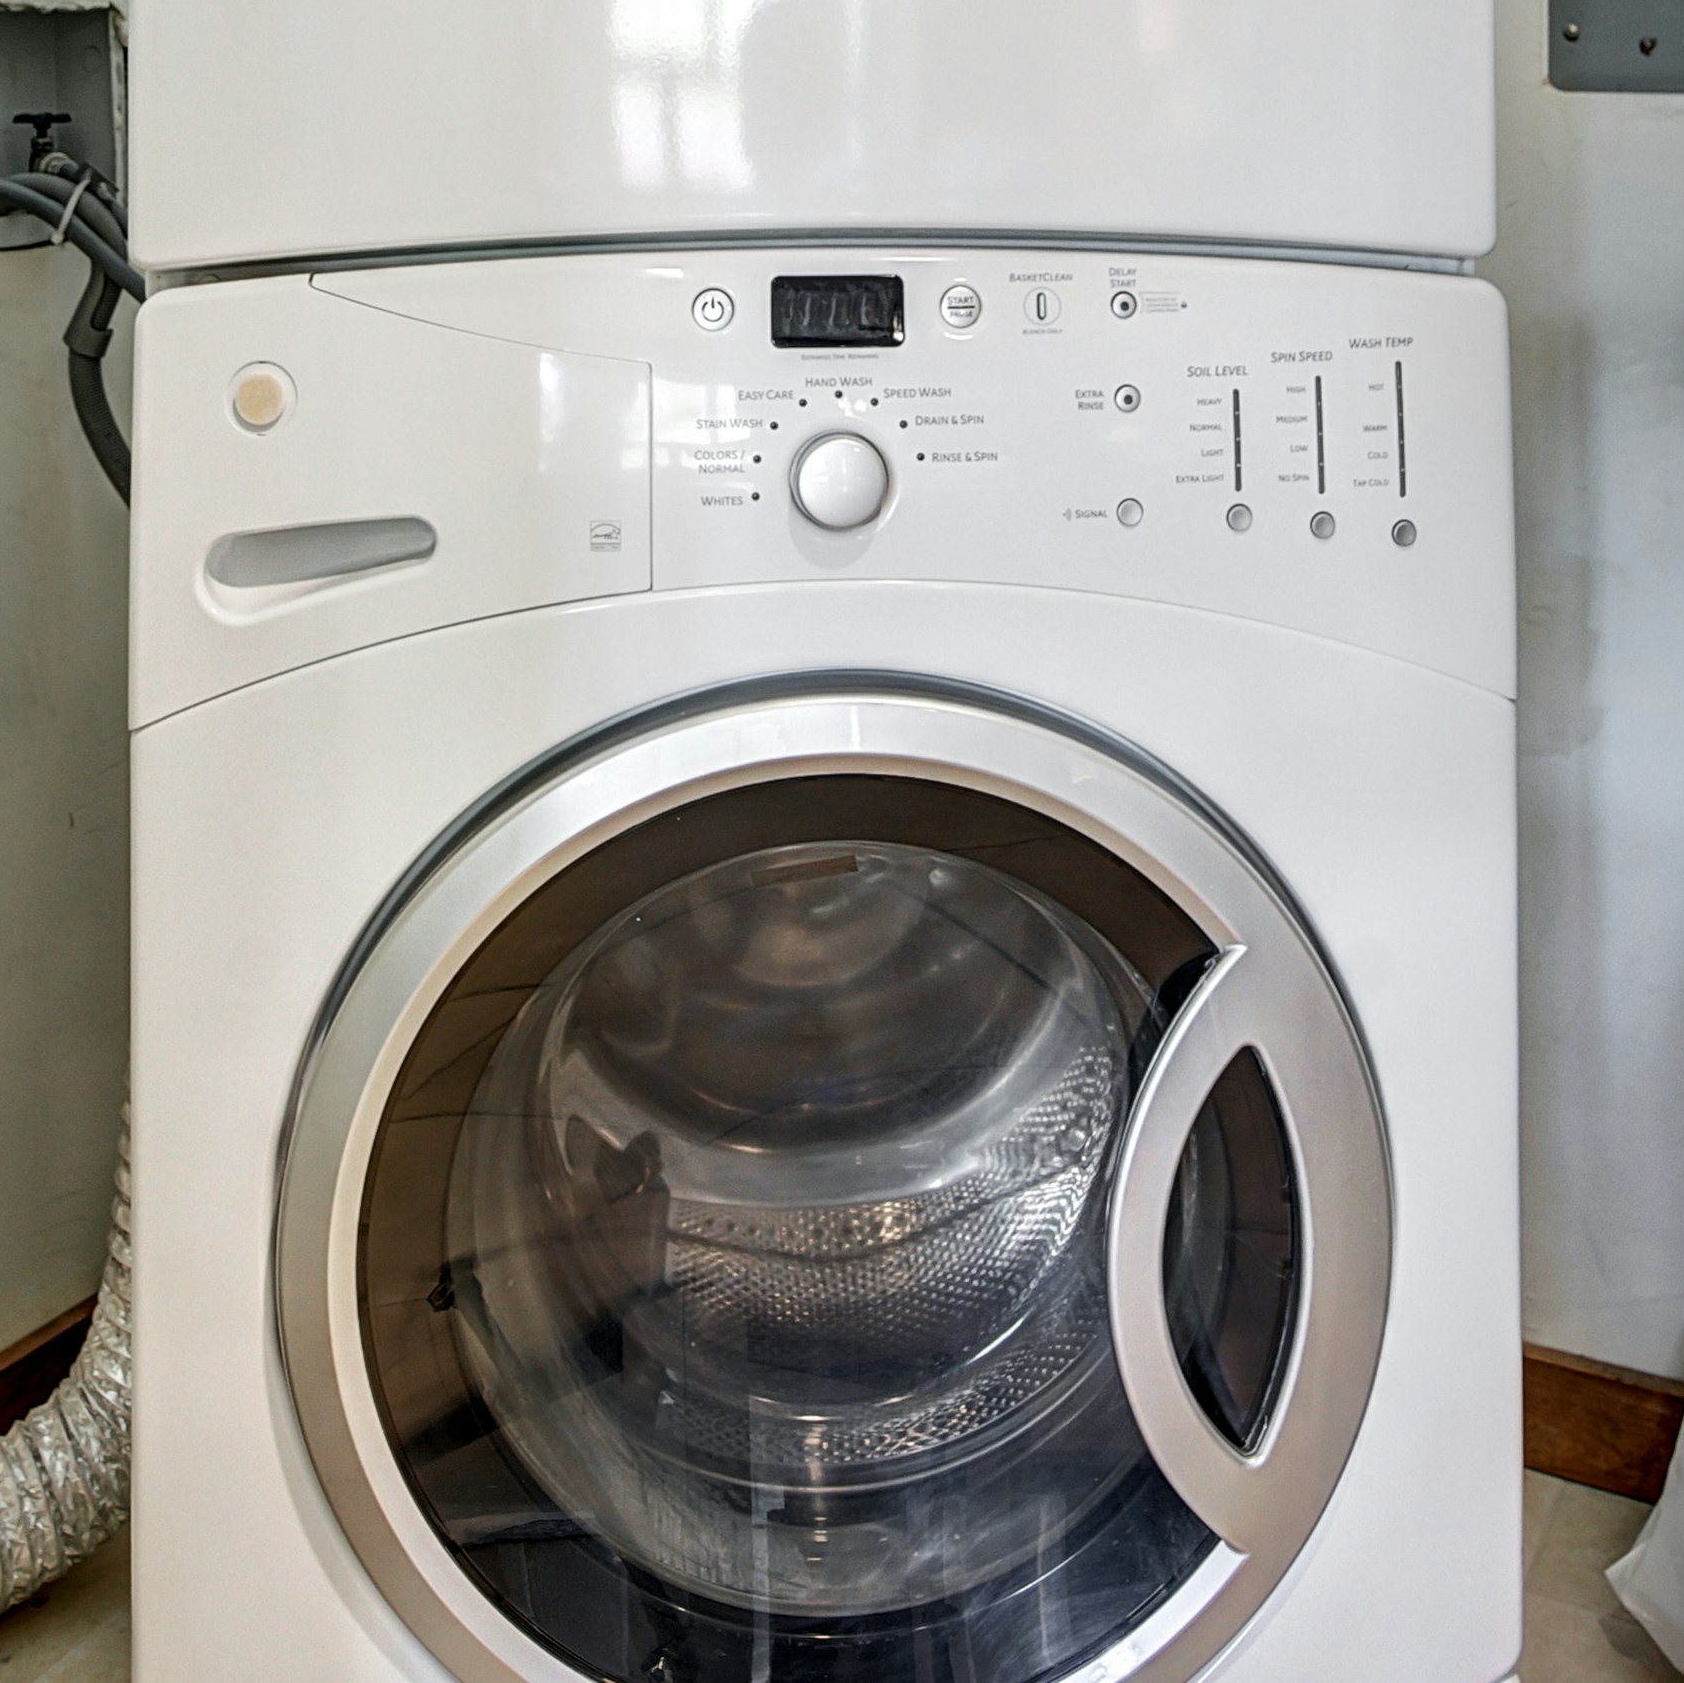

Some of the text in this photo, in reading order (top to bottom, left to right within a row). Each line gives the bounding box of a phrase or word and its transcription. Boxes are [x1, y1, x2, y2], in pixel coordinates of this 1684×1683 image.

[1108, 267, 1137, 277] DELAY
[1009, 273, 1073, 283] BASKETCLEAN
[1110, 279, 1136, 288] START
[947, 296, 974, 305] START
[1349, 336, 1414, 349] WASH TEMP
[1271, 350, 1333, 363] SPIN SPEED
[1187, 365, 1248, 377] SOIL LEVEL
[805, 377, 873, 388] HAND WASH
[738, 390, 794, 401] EASY CARE
[883, 387, 952, 398] SPEED WASH
[1075, 389, 1104, 398] EXTRA
[1078, 402, 1104, 410] RINSE
[1197, 398, 1222, 406] HEAVY
[696, 418, 763, 429] STAIN WASH
[915, 414, 984, 426] DRAIN & SPIN
[1276, 415, 1308, 423] MEDIUM
[1189, 423, 1222, 432] NORMAL
[1363, 424, 1387, 432] WARM
[1201, 448, 1224, 457] LIGHT
[1290, 444, 1308, 452] LOW
[694, 450, 739, 460] COLORS
[932, 451, 998, 463] RINSE & SPIN
[1368, 451, 1388, 460] COLD
[698, 464, 746, 474] NORMAL
[1176, 473, 1225, 483] EXTRA LIGHT
[1278, 473, 1310, 482] NO SPIN
[1353, 478, 1389, 487] TAP COLD
[701, 496, 744, 506] WHITES
[1075, 509, 1108, 519] SIGNAL
